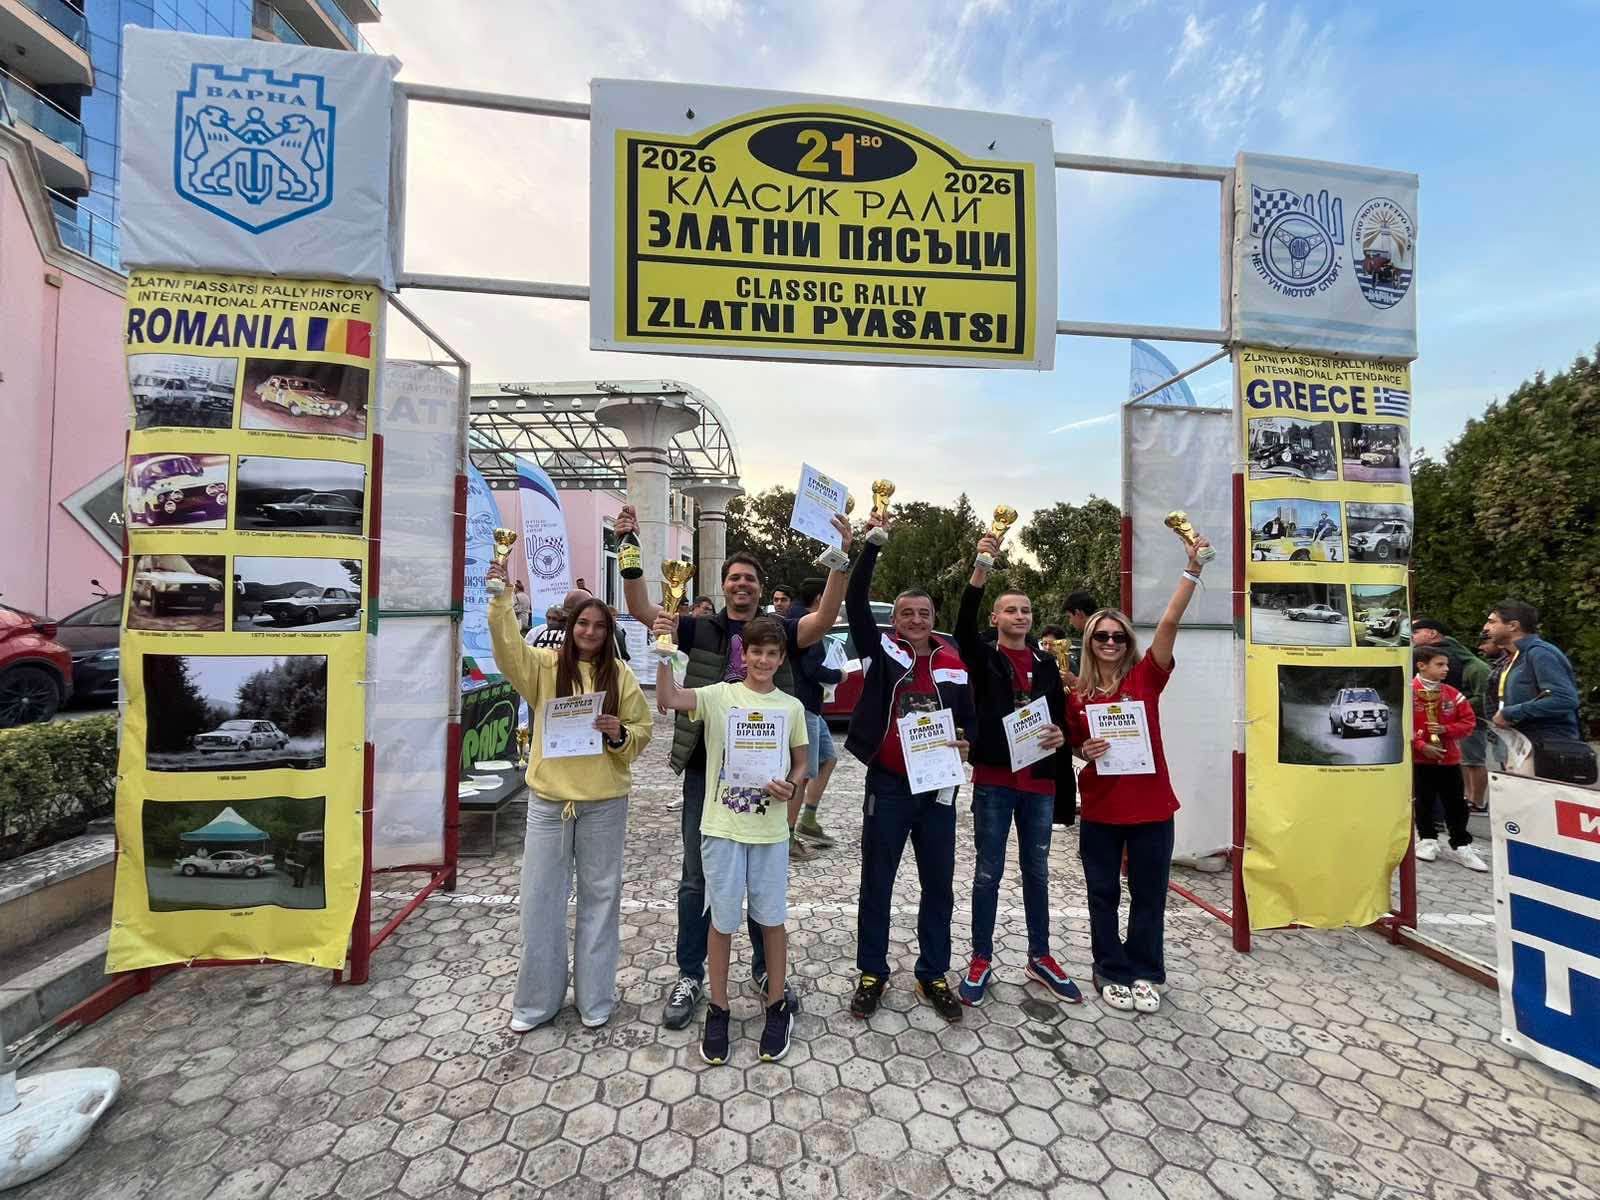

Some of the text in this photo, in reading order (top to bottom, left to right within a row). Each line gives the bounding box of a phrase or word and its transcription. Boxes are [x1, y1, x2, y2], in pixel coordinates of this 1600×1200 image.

[206, 86, 306, 106] ВАРНА
[641, 146, 717, 173] 2026
[944, 172, 1011, 195] 2026
[667, 175, 982, 225] КЛАСИК РАЛИ
[647, 209, 1011, 271] ЗЛАТНИ ПЯСЪЦИ
[1251, 252, 1344, 298] НЕПТУН МОТОР СПОРТ
[130, 277, 374, 301] ZLATNI PIASSATSI RALLY HISTORY
[735, 275, 927, 307] CLASSIC RALLY
[137, 290, 361, 314] INTERNATIONAL ATTENDANCE
[127, 307, 297, 351] ROMANIA
[646, 296, 1008, 343] ZLATNI PYASATSI
[1243, 353, 1409, 373] ZLATNI PIASSATSI RALLY HISTORY
[1254, 365, 1402, 385] INTERNATIONAL ATTENDANCE
[1246, 379, 1368, 415] GREECE
[808, 476, 838, 498] ГРАМОТА
[736, 722, 775, 730] ГРАМОТА
[1013, 711, 1041, 729] ГРАМОТА
[1014, 716, 1042, 734] DIPLOMA
[1098, 713, 1135, 721] ГРАМОТА
[736, 729, 776, 737] DIPLOMA
[909, 722, 944, 736] ГРАМОТА
[910, 729, 945, 741] DIPLOMA
